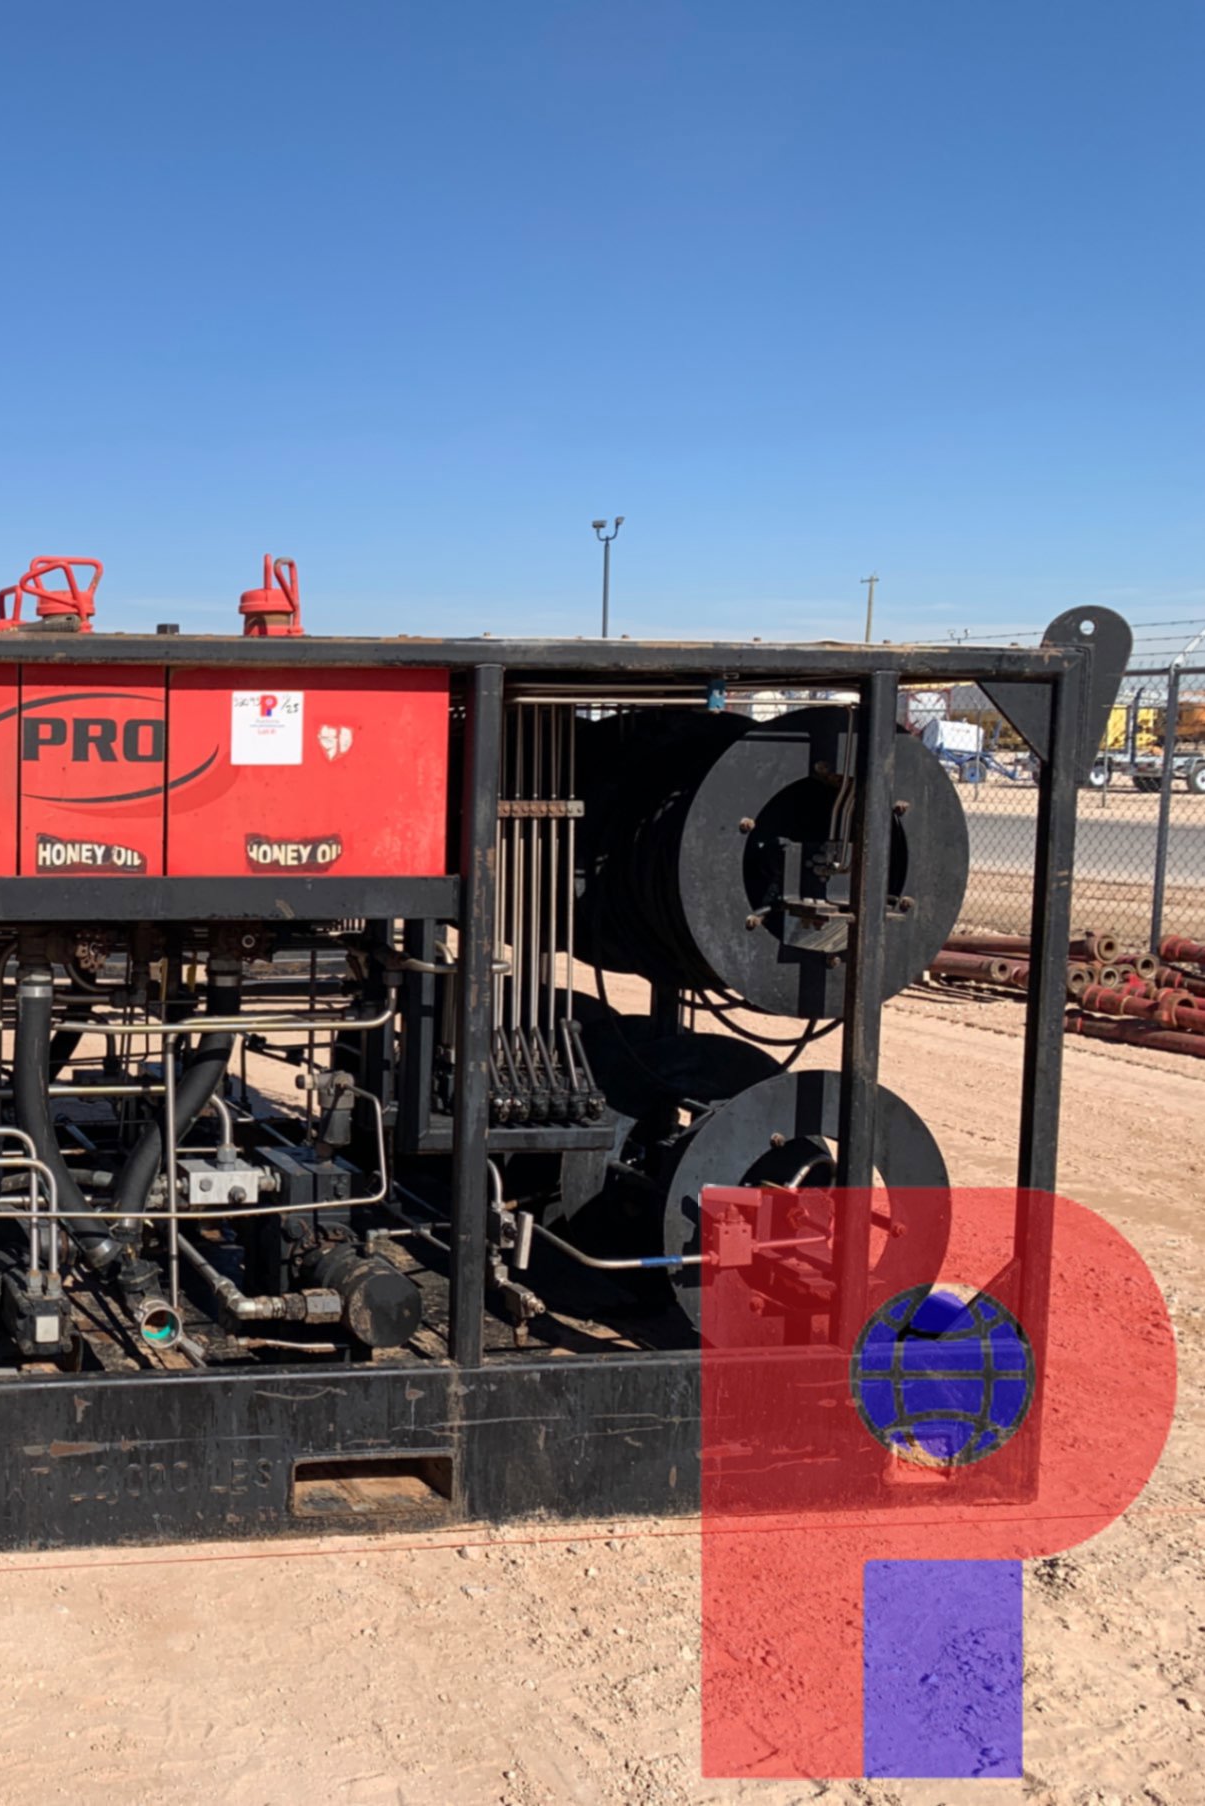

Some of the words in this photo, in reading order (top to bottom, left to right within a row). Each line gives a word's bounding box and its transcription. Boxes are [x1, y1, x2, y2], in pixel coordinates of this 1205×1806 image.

[23, 717, 165, 762] PRO
[38, 843, 106, 866] HONEY
[112, 845, 142, 866] OIL
[247, 843, 313, 866] HONEY
